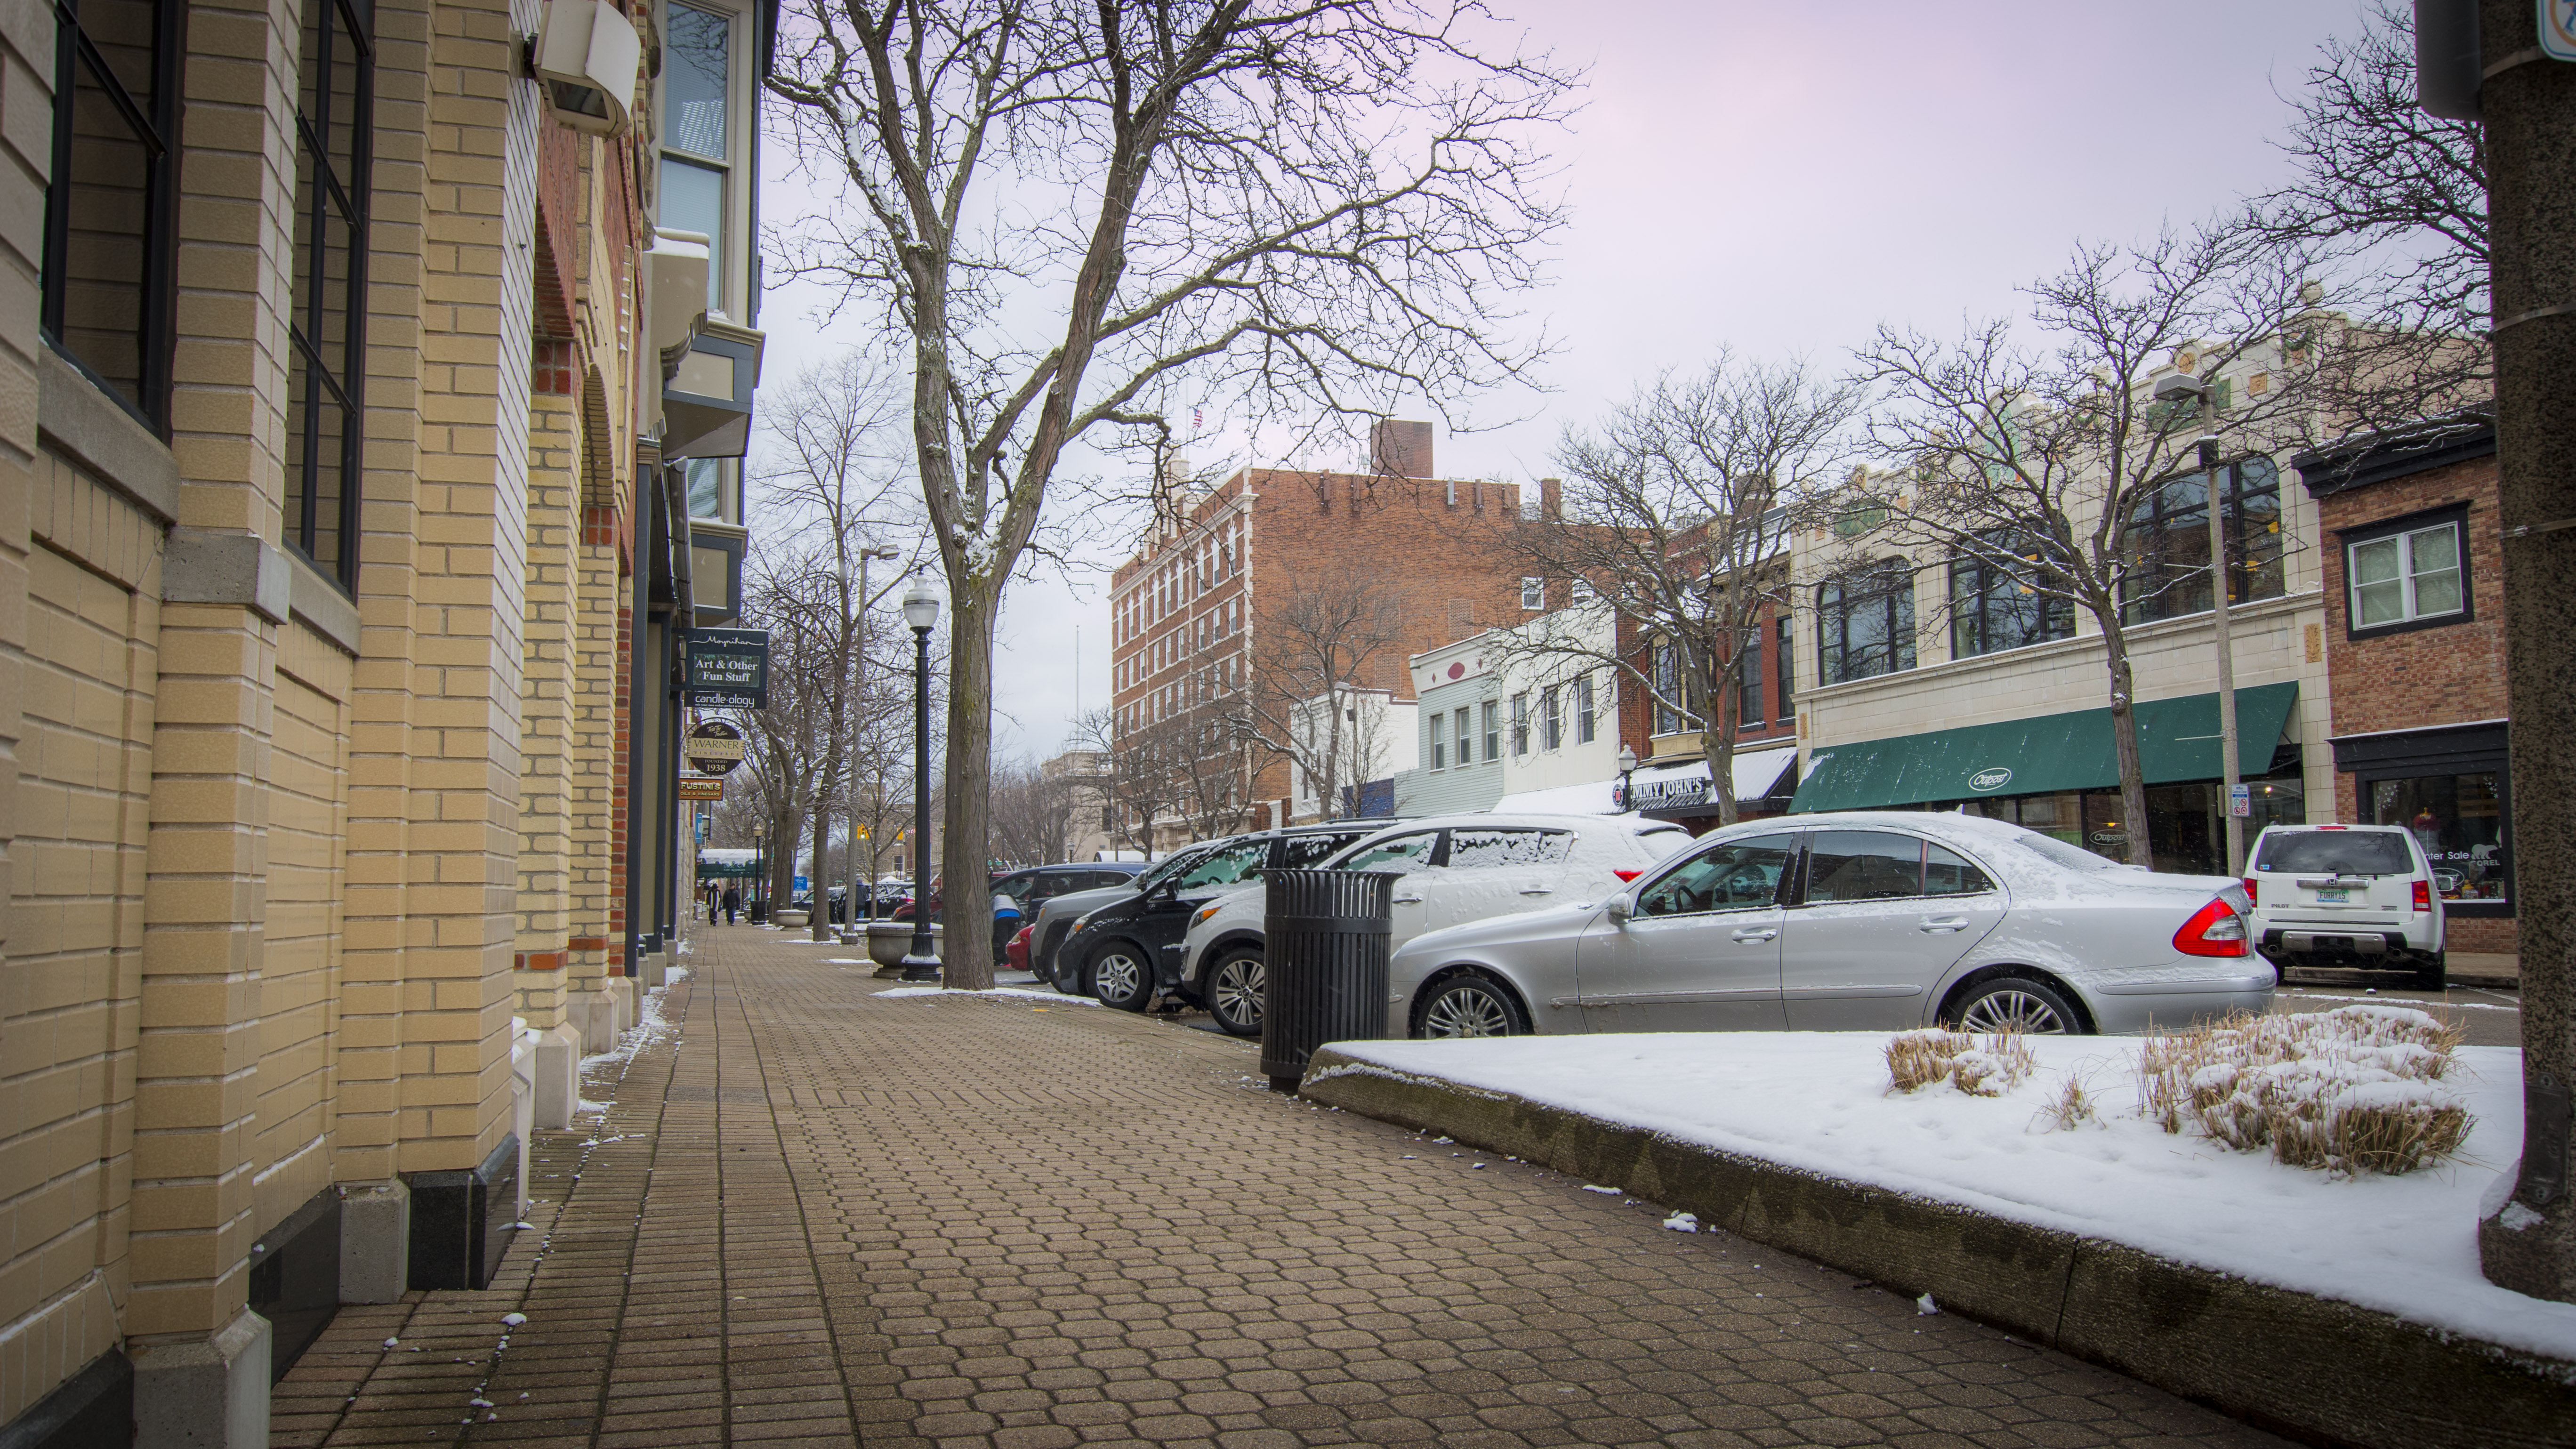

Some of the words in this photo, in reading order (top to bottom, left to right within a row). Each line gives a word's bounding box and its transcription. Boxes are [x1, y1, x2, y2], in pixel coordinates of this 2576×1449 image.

[689, 636, 764, 647] Moynihan
[695, 659, 714, 668] Art
[716, 660, 725, 669] &
[729, 660, 758, 670] Other
[702, 671, 723, 681] Fun
[725, 672, 751, 682] Stuff
[694, 740, 739, 749] WARNER
[1974, 772, 2008, 787] Outpost
[681, 781, 721, 790] FUSTINI'S
[1631, 782, 1661, 799] MMY
[1663, 777, 1703, 800] JOHN'S
[2094, 833, 2126, 843] Outpost
[2425, 852, 2444, 860] nter
[2448, 851, 2469, 860] Sale
